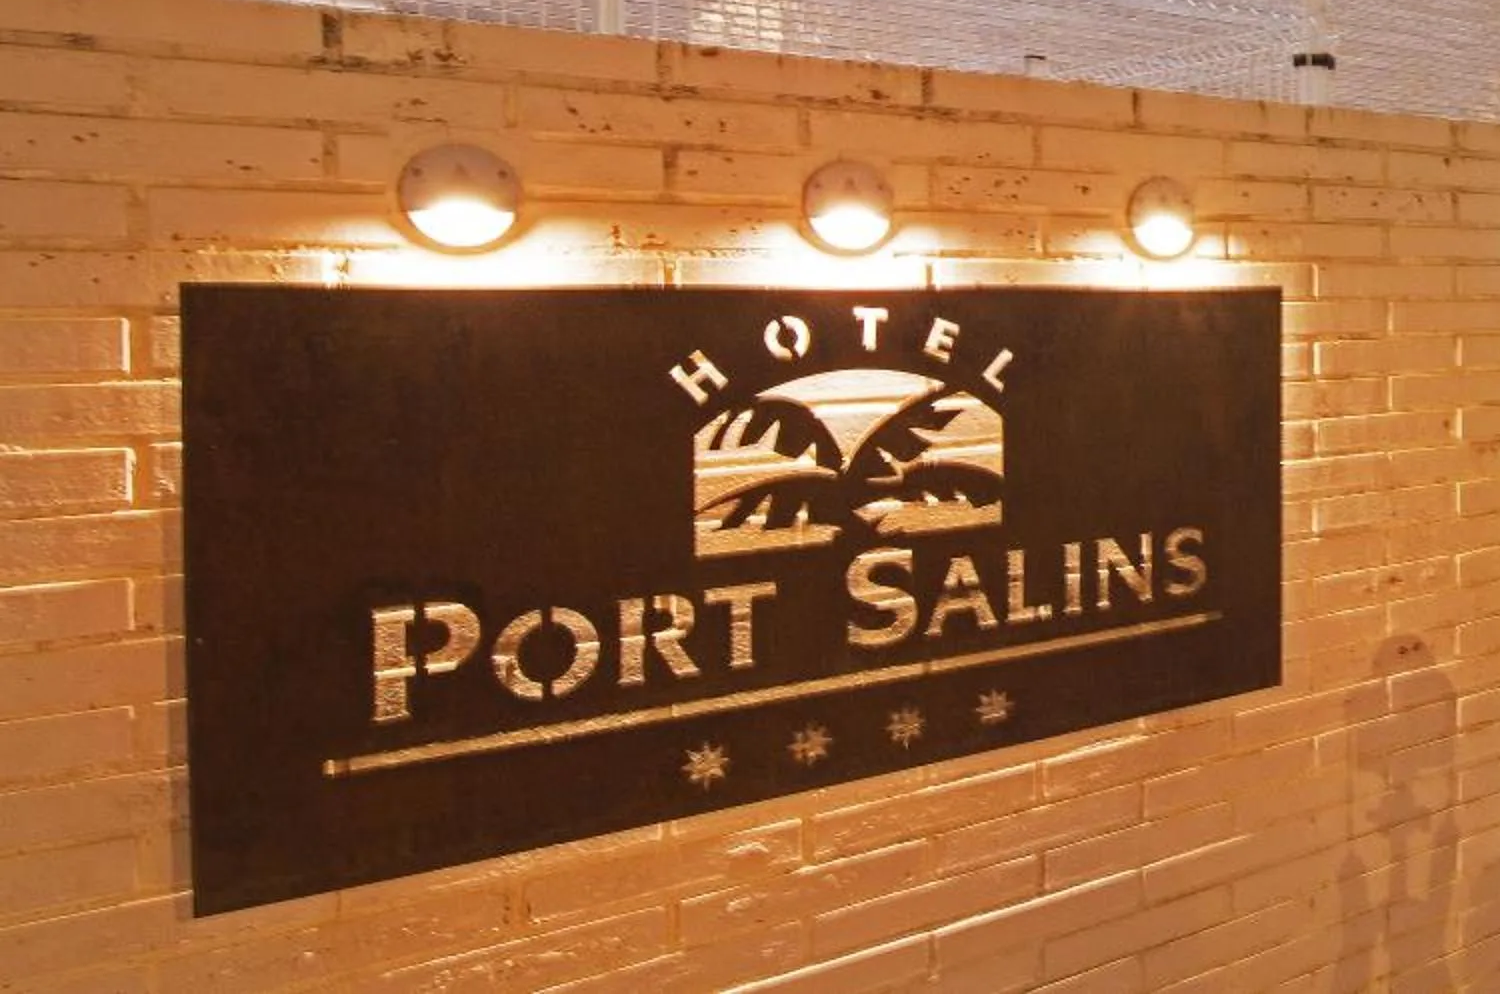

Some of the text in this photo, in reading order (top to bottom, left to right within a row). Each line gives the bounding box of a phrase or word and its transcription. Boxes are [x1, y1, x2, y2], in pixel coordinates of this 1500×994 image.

[669, 305, 1013, 405] HOTEL
[370, 526, 1208, 724] PORT SALINS
